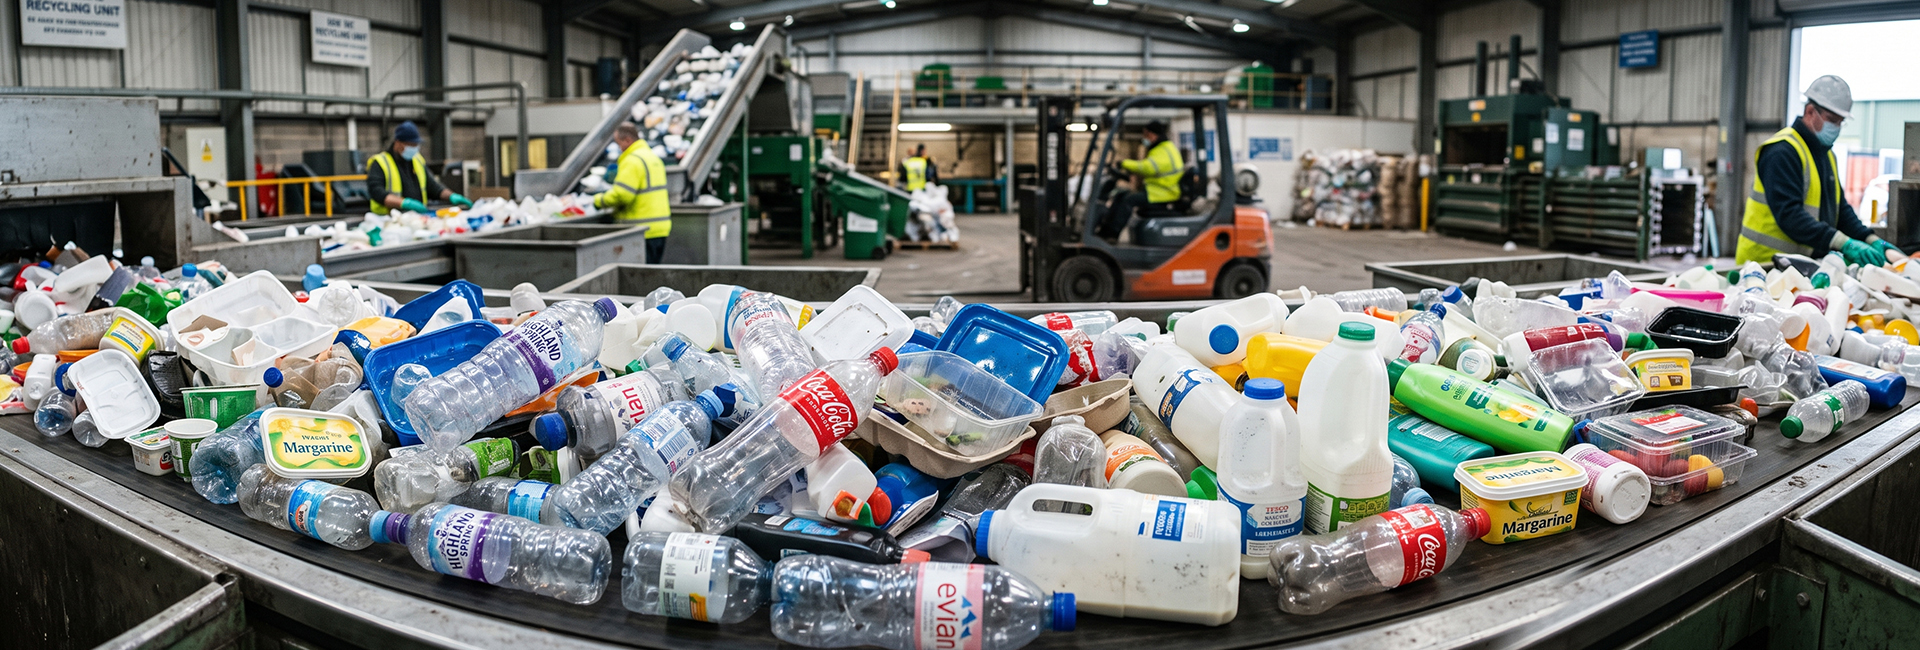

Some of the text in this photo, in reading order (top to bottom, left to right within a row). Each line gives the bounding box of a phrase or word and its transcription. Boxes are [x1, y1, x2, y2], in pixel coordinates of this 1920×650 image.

[26, 0, 120, 16] RECYCLING UNIT
[283, 441, 354, 457] Margarine
[1484, 465, 1563, 481] Margarine
[1502, 513, 1573, 534] Margarine
[446, 512, 475, 570] HIGHLAND
[459, 524, 475, 557] SPRING
[936, 583, 959, 650] evian
